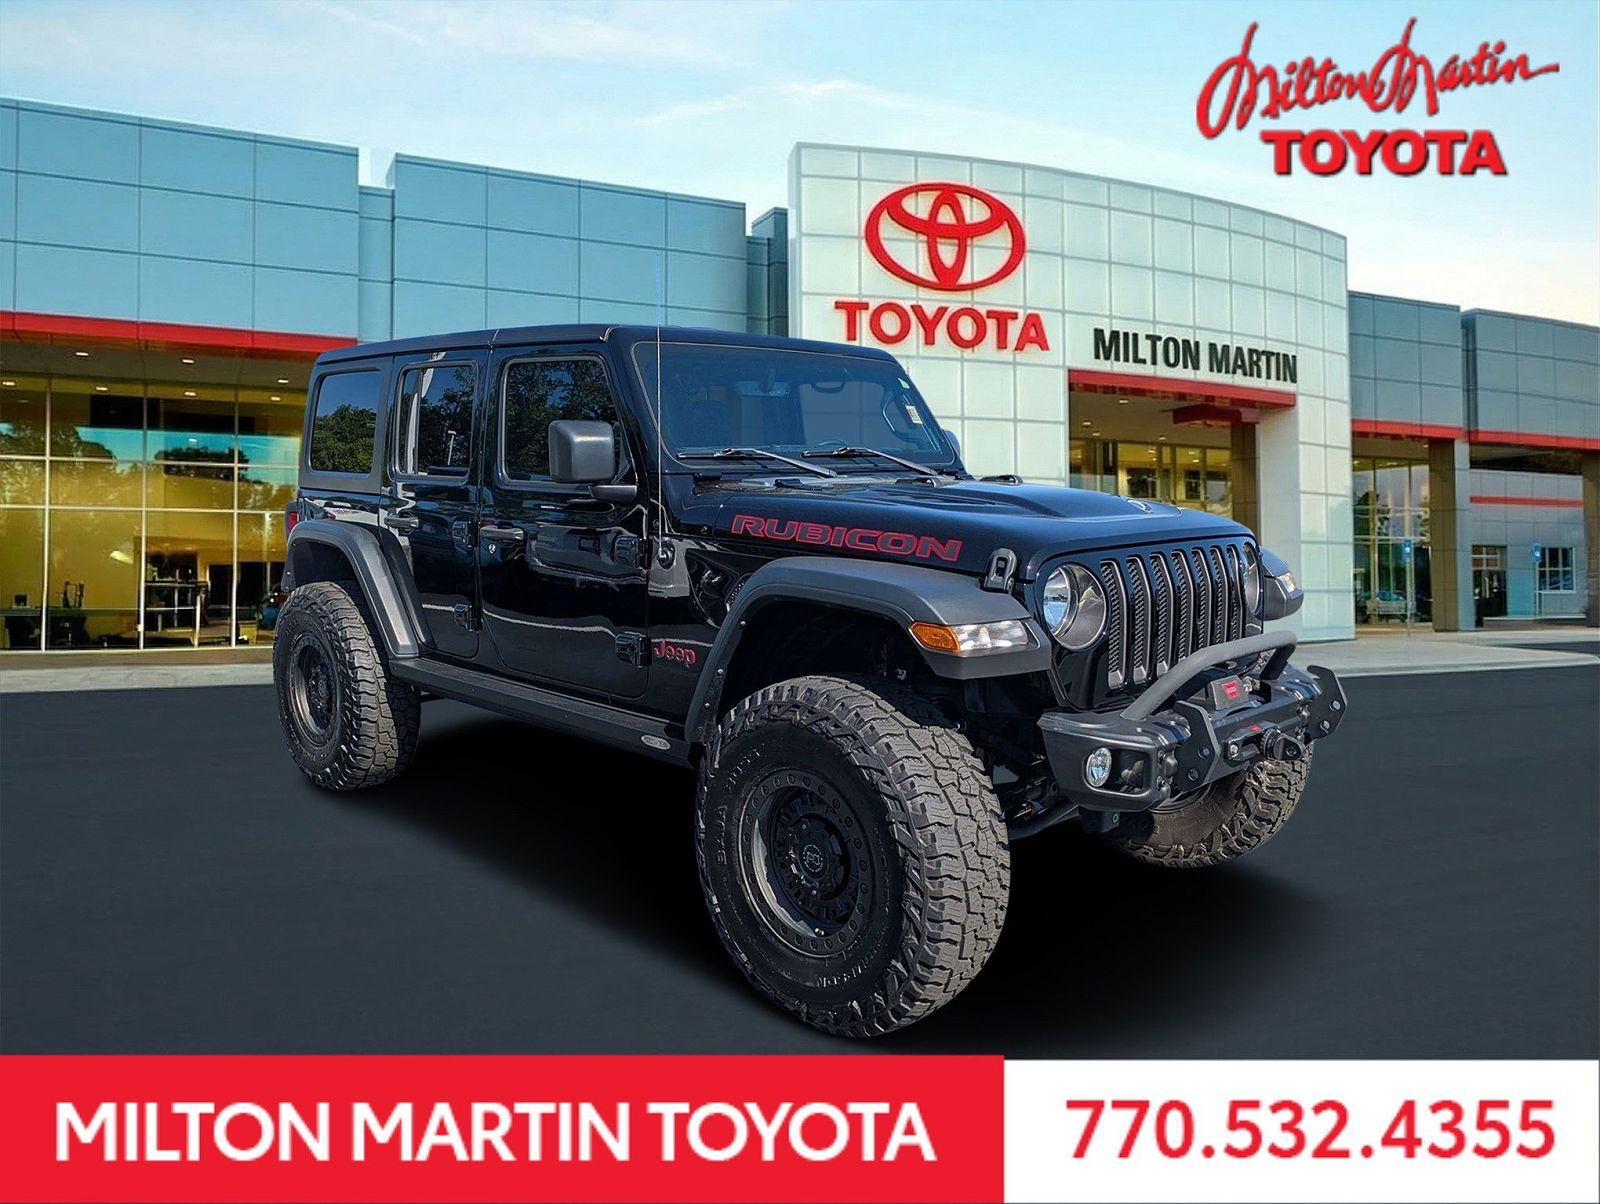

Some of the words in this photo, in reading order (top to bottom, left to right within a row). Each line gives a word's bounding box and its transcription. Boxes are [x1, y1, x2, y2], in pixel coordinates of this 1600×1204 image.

[834, 300, 1051, 353] TOYOTA
[1093, 327, 1200, 371] MILTON
[1208, 343, 1298, 384] MARTIN
[731, 514, 964, 562] RUBICON
[653, 640, 697, 666] Jeep
